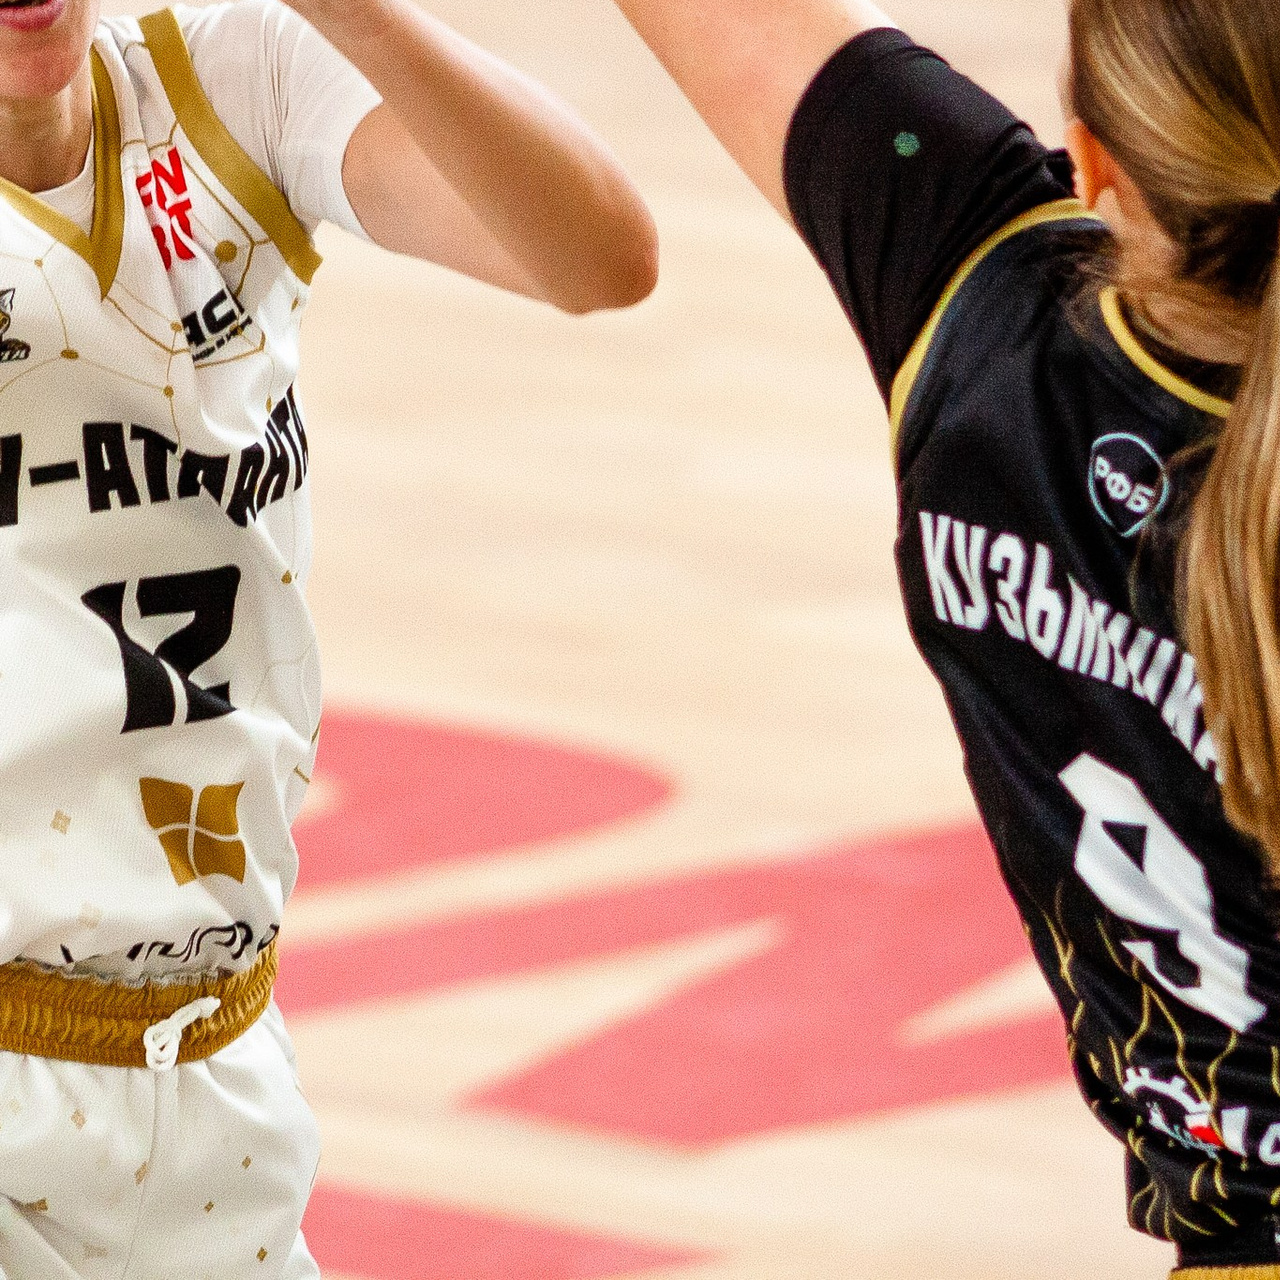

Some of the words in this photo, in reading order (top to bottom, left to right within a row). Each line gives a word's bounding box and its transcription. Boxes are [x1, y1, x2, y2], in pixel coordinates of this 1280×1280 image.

[1095, 456, 1156, 514] РФБ
[80, 563, 242, 734] 12
[1057, 751, 1268, 1034] 9
